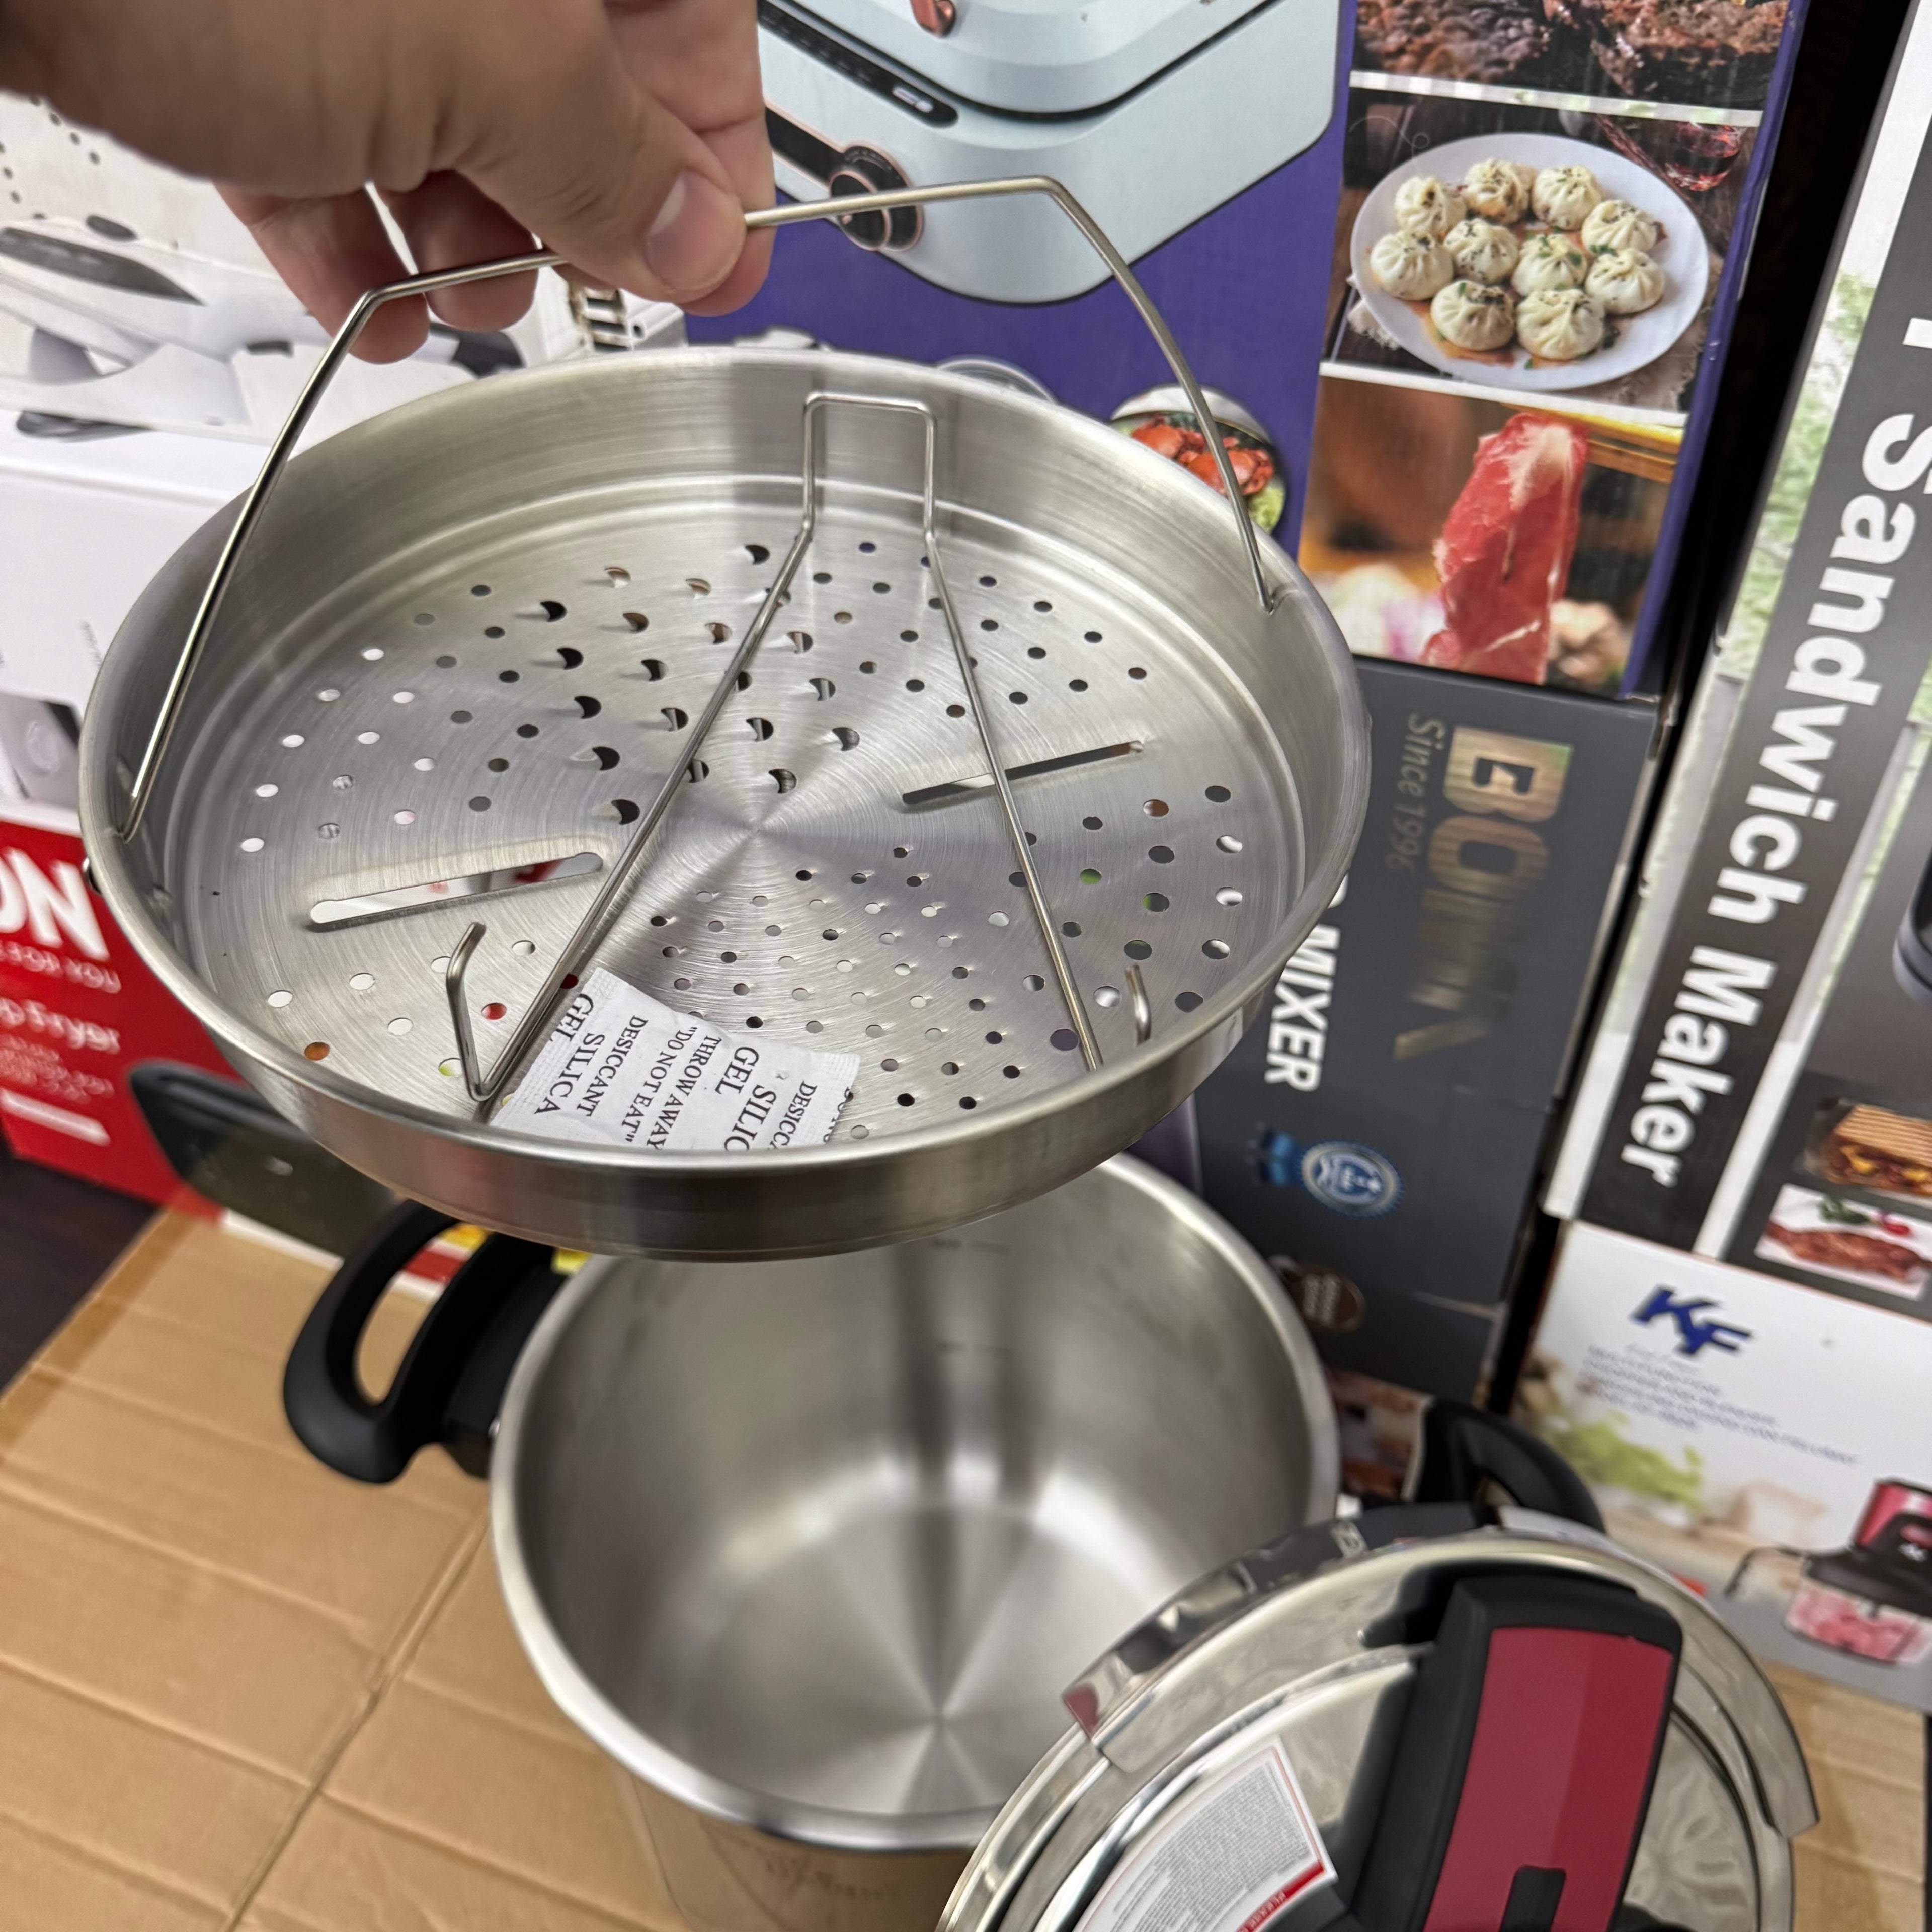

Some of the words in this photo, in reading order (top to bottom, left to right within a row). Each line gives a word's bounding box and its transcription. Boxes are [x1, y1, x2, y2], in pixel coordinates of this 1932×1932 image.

[1707, 413, 1932, 925] Sandwich
[1397, 712, 1446, 798] Since
[1264, 923, 1341, 1092] MIXER
[534, 1033, 605, 1114] SILICA
[577, 1015, 649, 1116] DESICCANT
[643, 1051, 678, 1093] NOT
[675, 1035, 722, 1096] THROW
[715, 1046, 759, 1094] GEL
[1621, 944, 1779, 1188] Maker
[647, 1093, 684, 1150] AWAY
[724, 1084, 777, 1151] SILIC
